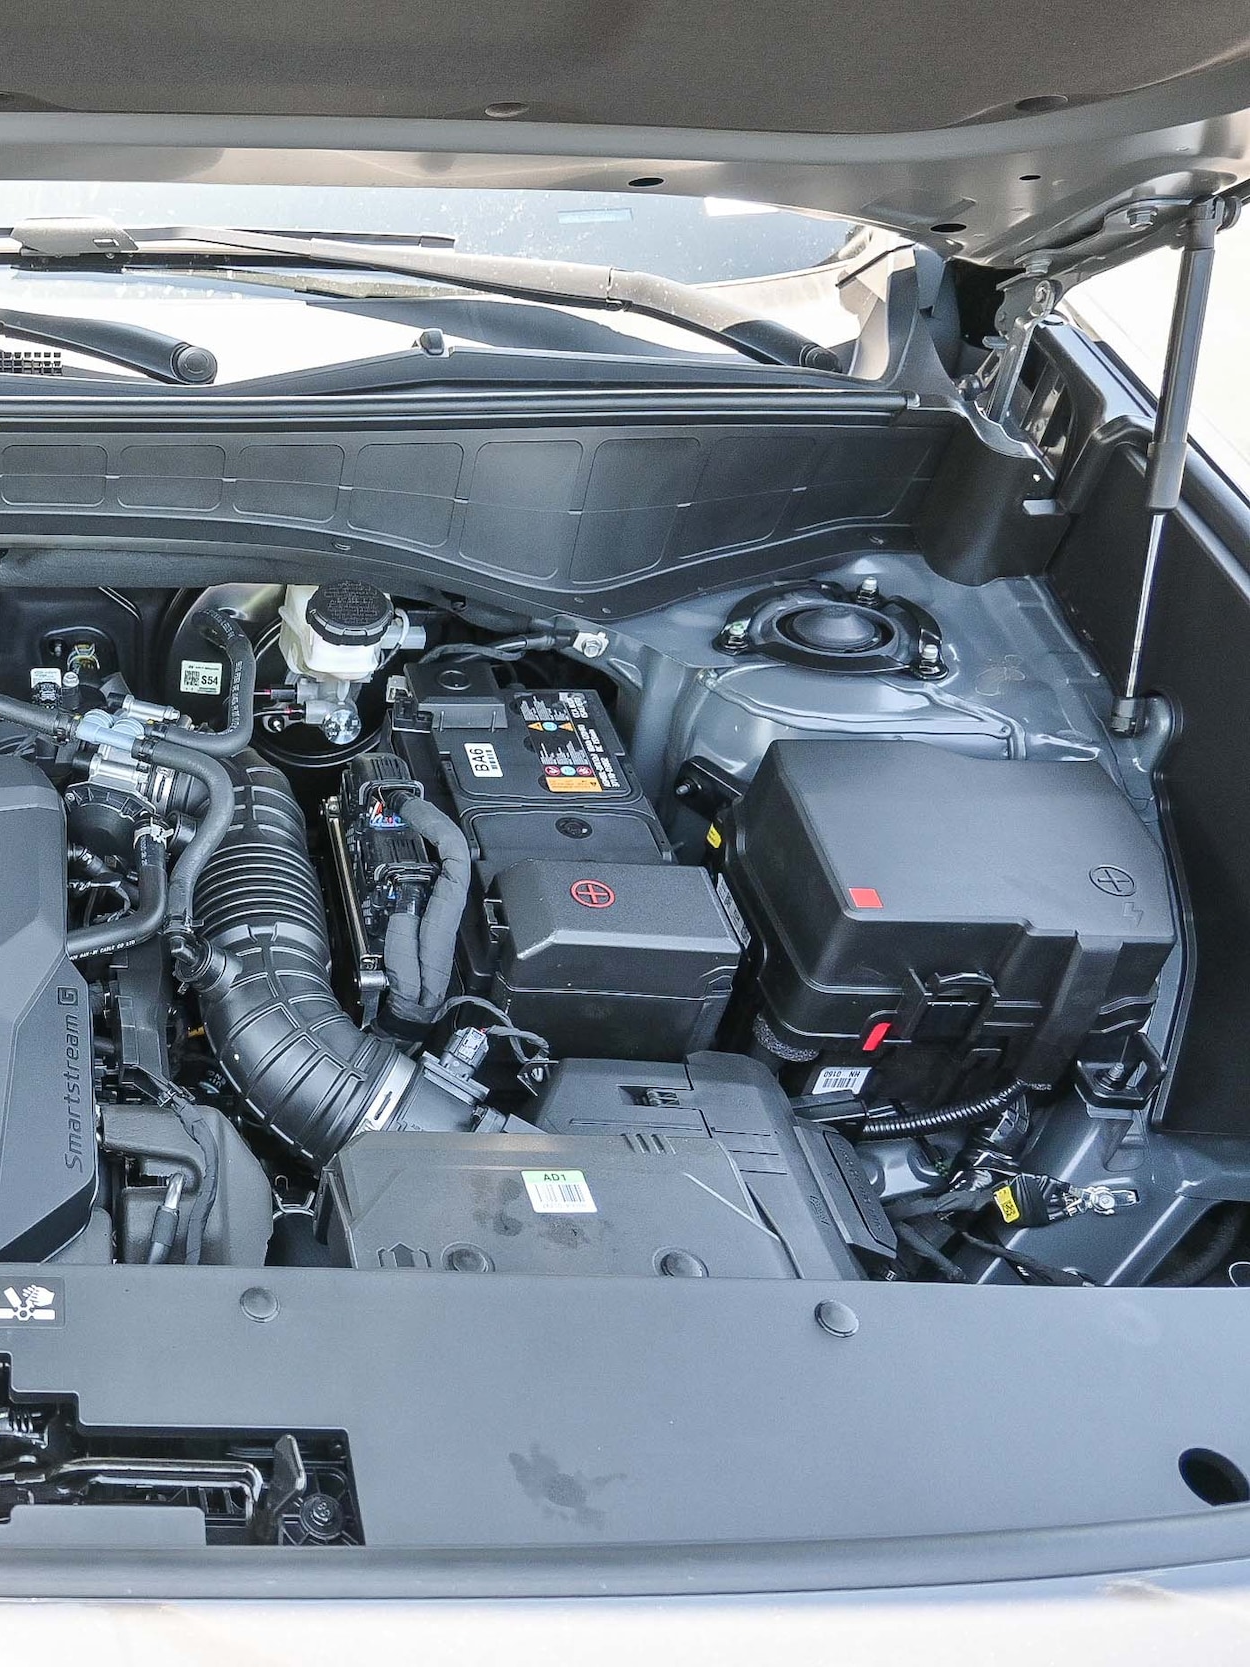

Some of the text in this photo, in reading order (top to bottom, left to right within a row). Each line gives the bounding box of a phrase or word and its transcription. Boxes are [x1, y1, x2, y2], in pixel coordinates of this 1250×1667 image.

[201, 675, 218, 685] S54
[469, 748, 490, 772] BA6
[64, 1013, 83, 1174] Smartstream
[543, 1173, 566, 1181] AD1
